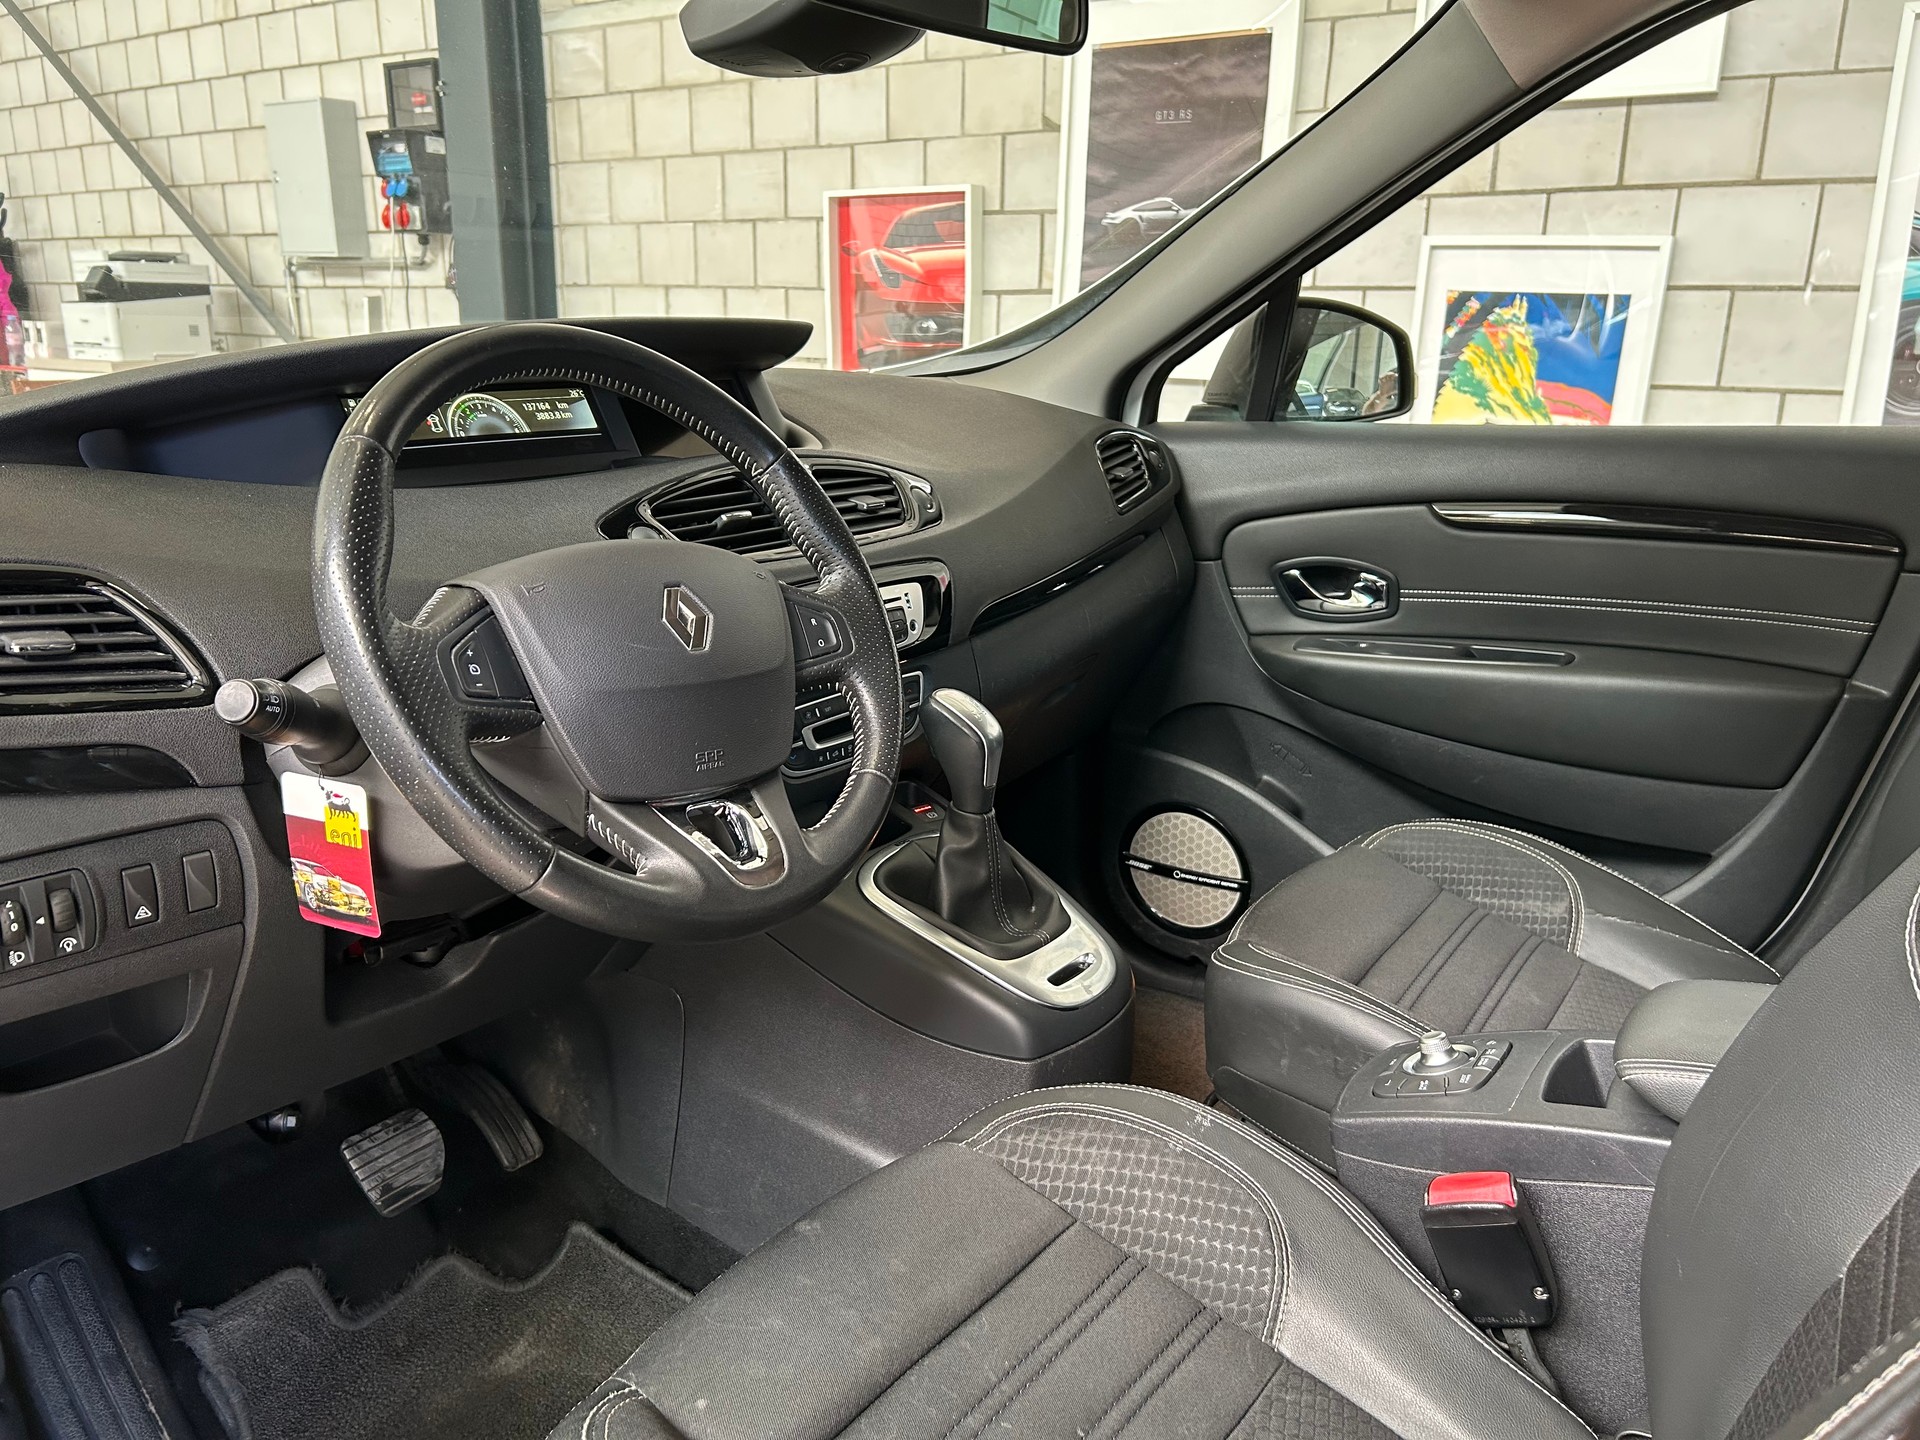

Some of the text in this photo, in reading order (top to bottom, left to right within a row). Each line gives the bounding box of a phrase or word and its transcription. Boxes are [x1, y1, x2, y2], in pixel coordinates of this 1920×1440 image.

[1155, 109, 1193, 120] GT3 RS
[522, 401, 569, 411] 137164 km
[811, 618, 817, 626] R
[265, 705, 280, 713] AUTO
[330, 827, 358, 849] eni
[8, 911, 15, 920] 1
[10, 922, 19, 932] 0
